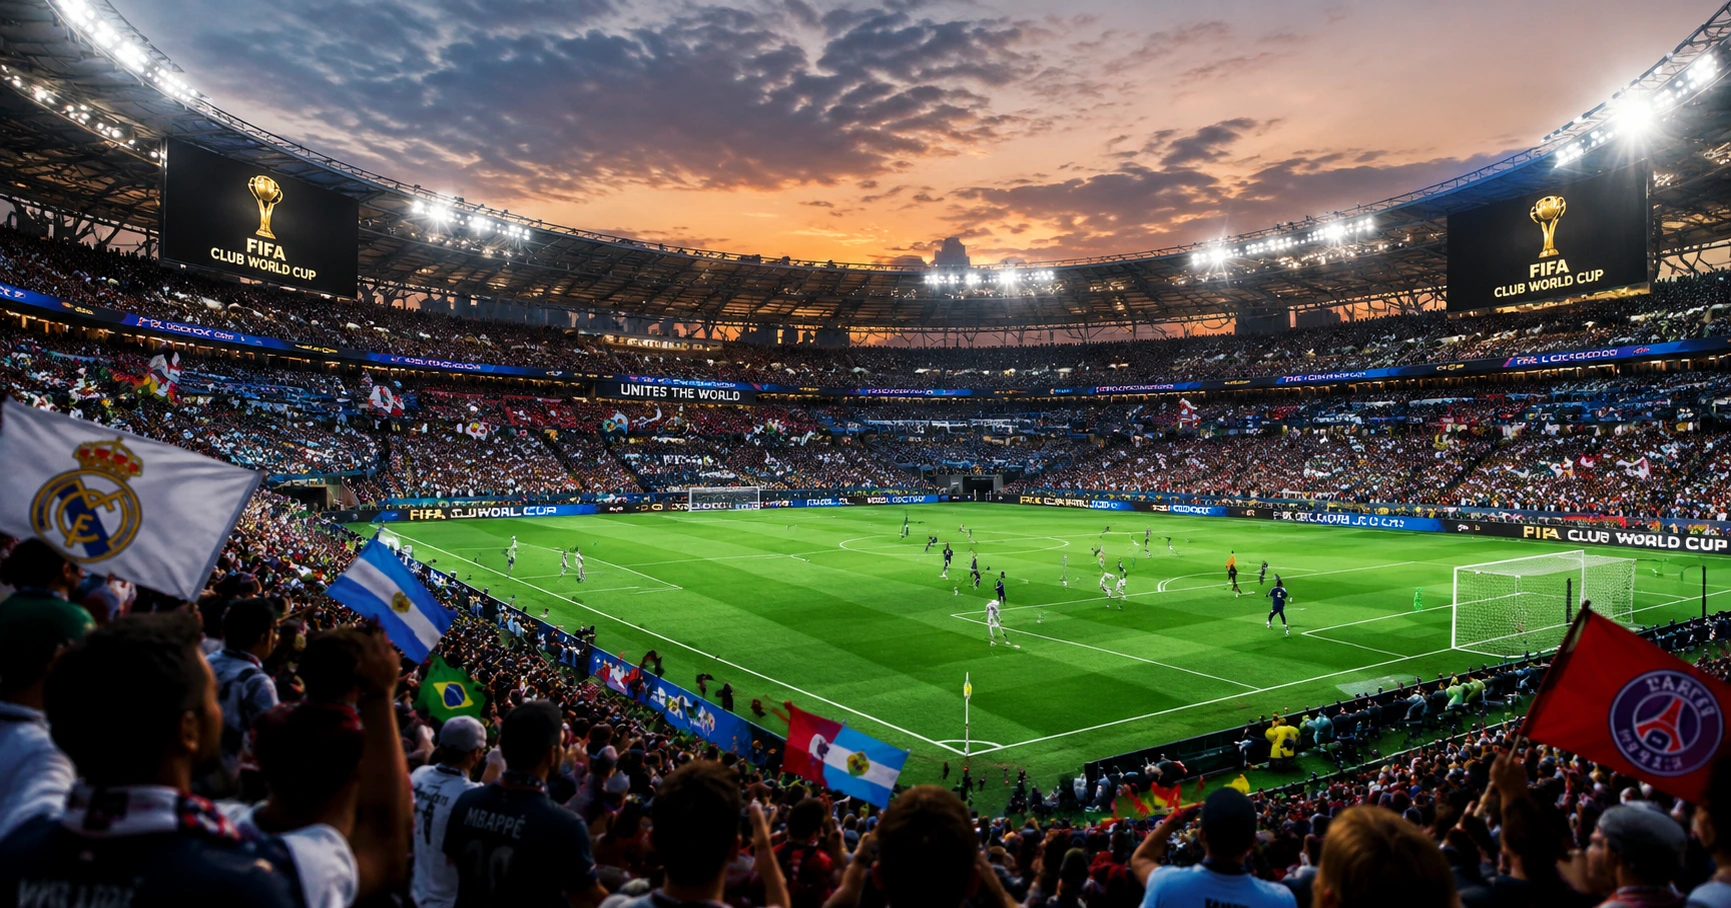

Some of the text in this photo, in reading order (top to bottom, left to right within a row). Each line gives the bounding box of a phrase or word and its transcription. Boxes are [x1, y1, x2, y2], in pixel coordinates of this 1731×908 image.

[246, 237, 286, 261] FIFA
[210, 247, 317, 280] CLUB WORLD CUP
[1529, 259, 1570, 278] FIFA
[1494, 269, 1604, 298] CLUB WORLD CUP
[620, 383, 741, 401] UNITES THE WORLD
[1567, 529, 1610, 544] CLUB
[1616, 532, 1681, 549] WORLD
[1685, 536, 1728, 551] CUP
[463, 807, 526, 839] MBAPPÉ
